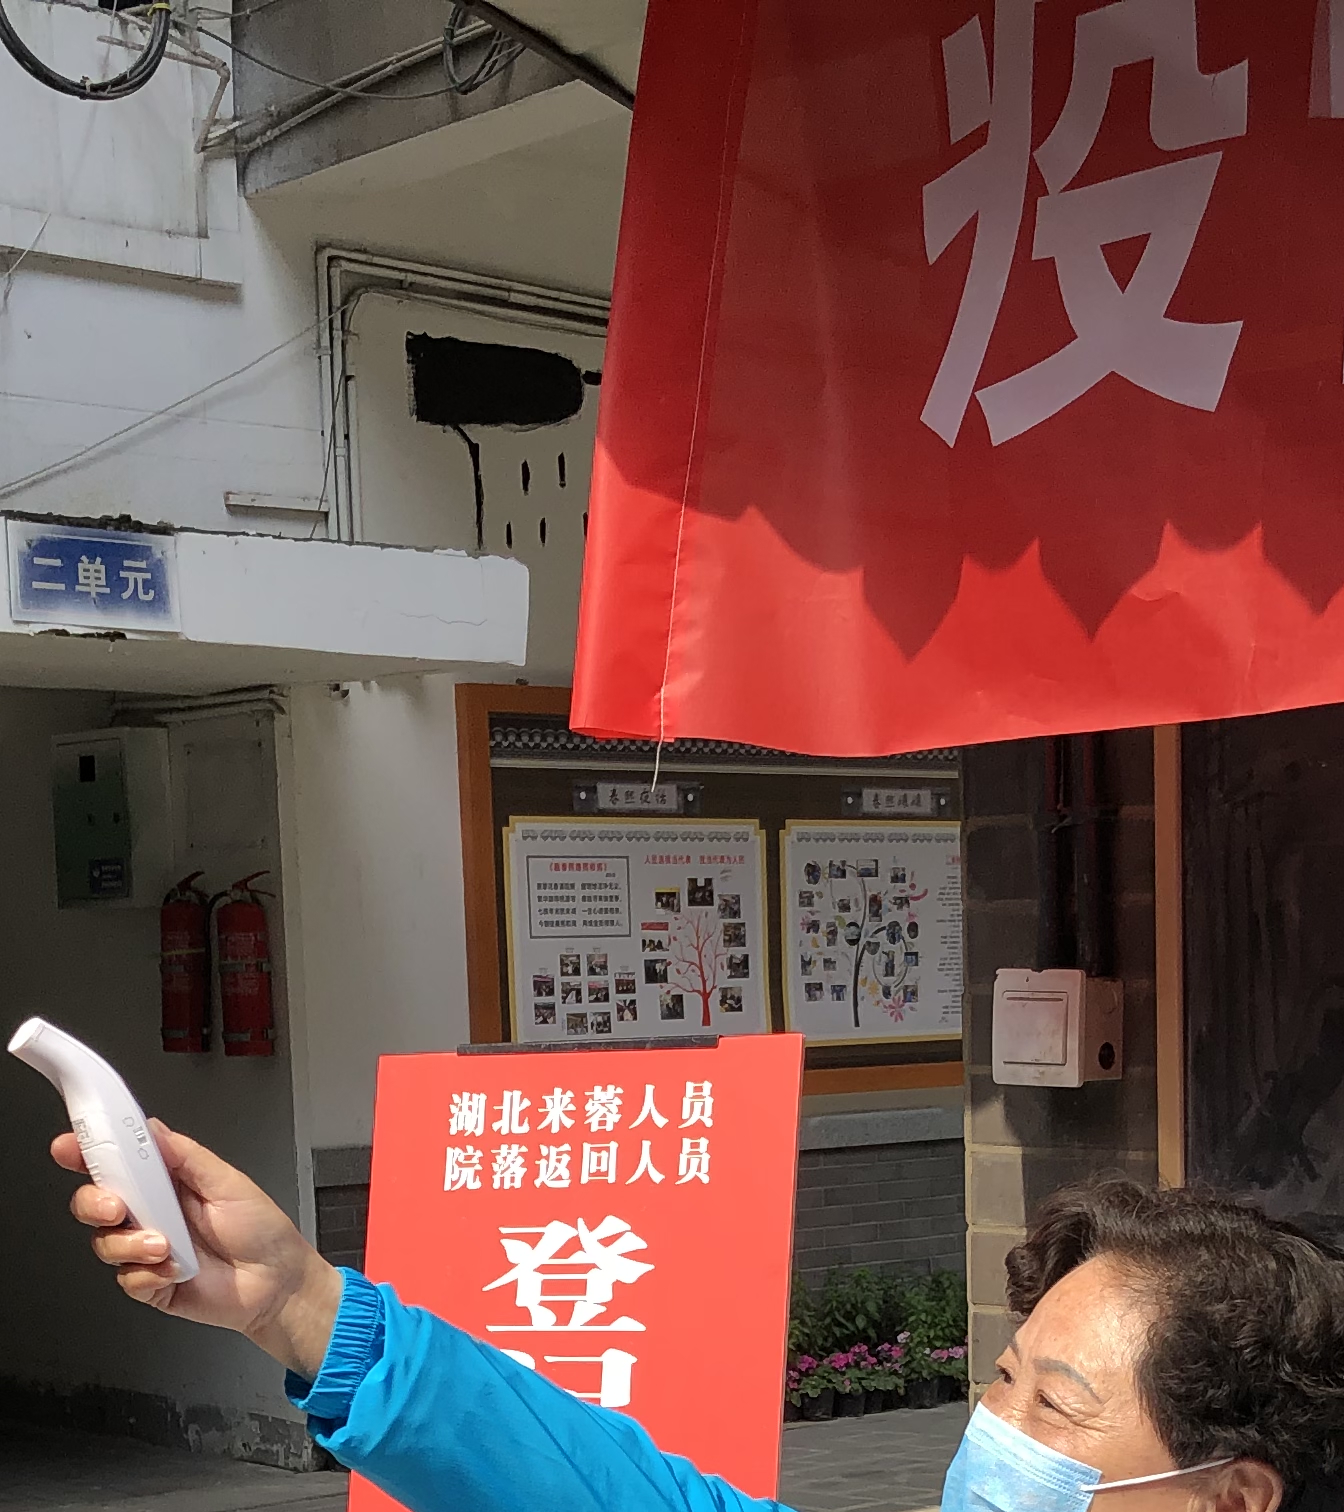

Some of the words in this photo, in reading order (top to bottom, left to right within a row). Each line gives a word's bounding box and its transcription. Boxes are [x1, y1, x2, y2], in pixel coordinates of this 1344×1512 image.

[31, 554, 155, 602] 二单元
[447, 1080, 715, 1137] 湖北来蓉人员
[443, 1137, 713, 1192] 院落返回人员
